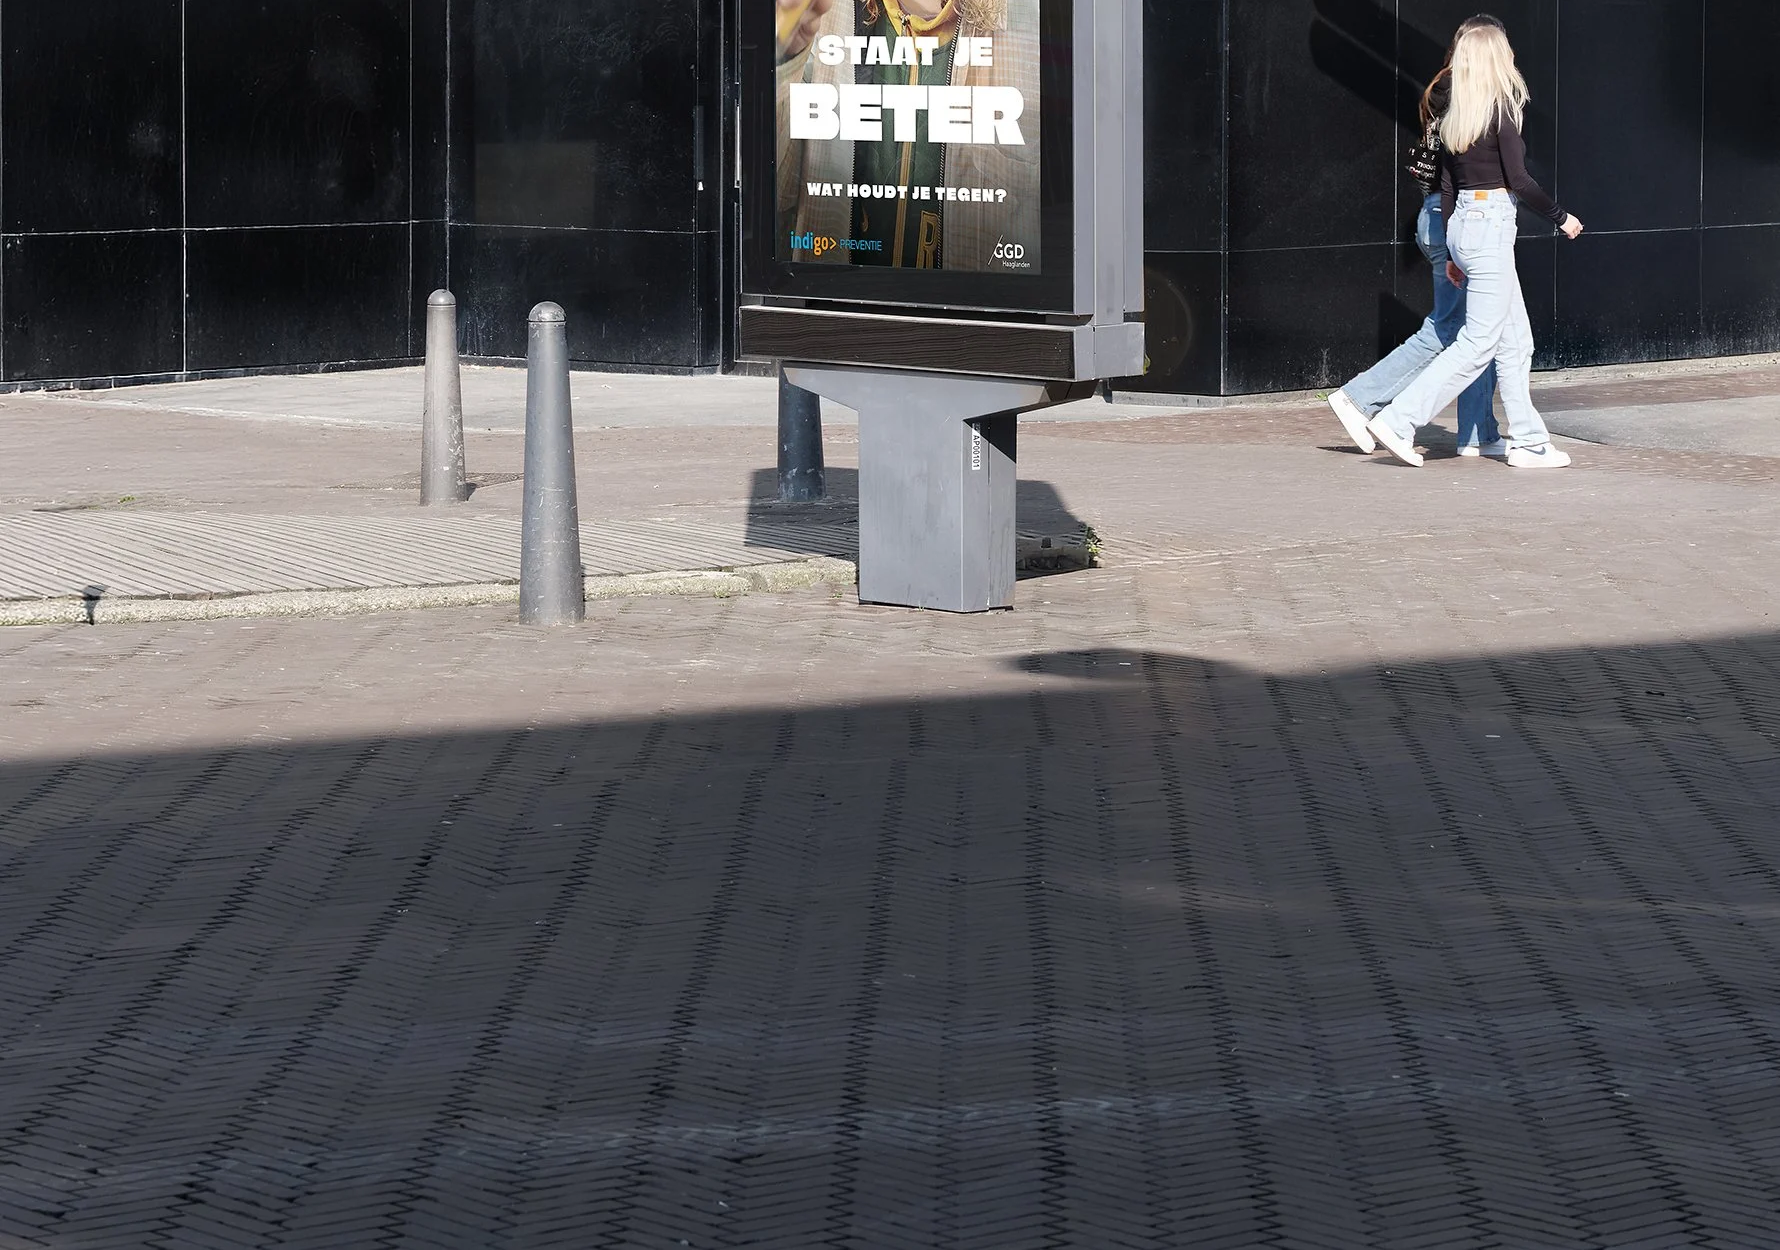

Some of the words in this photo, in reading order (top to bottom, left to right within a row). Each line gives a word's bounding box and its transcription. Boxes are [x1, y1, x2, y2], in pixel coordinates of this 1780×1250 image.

[818, 34, 939, 66] STAAT
[954, 36, 993, 67] JE
[789, 82, 1025, 145] BETER
[807, 182, 843, 197] WAT
[846, 184, 908, 199] HOUDT
[912, 186, 931, 200] JE
[935, 187, 1007, 203] TEGEN?
[839, 238, 882, 251] PREVENTIE
[994, 243, 1024, 259] GGD
[1002, 260, 1031, 270] Haaglanden
